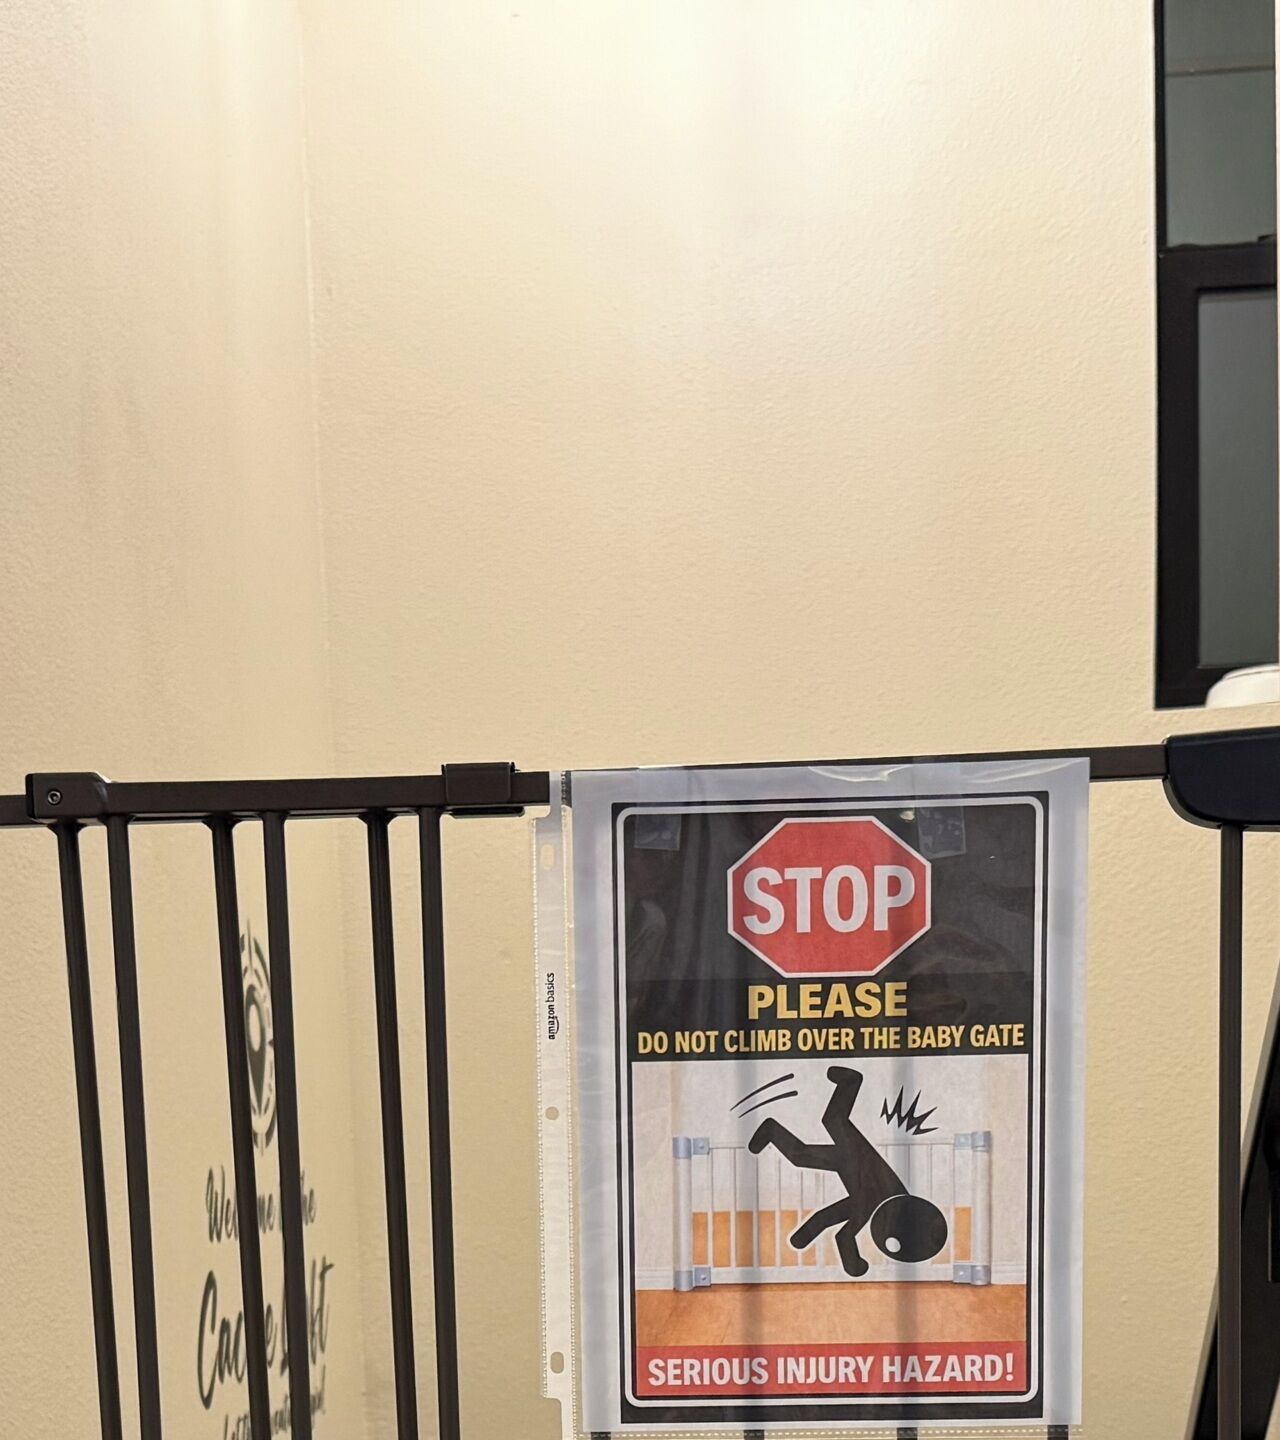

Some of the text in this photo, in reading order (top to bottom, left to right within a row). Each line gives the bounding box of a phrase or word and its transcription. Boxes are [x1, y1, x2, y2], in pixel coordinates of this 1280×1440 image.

[743, 865, 915, 935] STOP
[545, 972, 558, 1040] amazon basics
[747, 982, 908, 1020] PLEASE
[638, 1024, 1024, 1054] DO NOT CLIMB OVER THE BABY GATE
[206, 1165, 276, 1242] Welme
[198, 1270, 277, 1410] Cace
[648, 1353, 1014, 1386] SERIOUS INJURY HAZARD!
